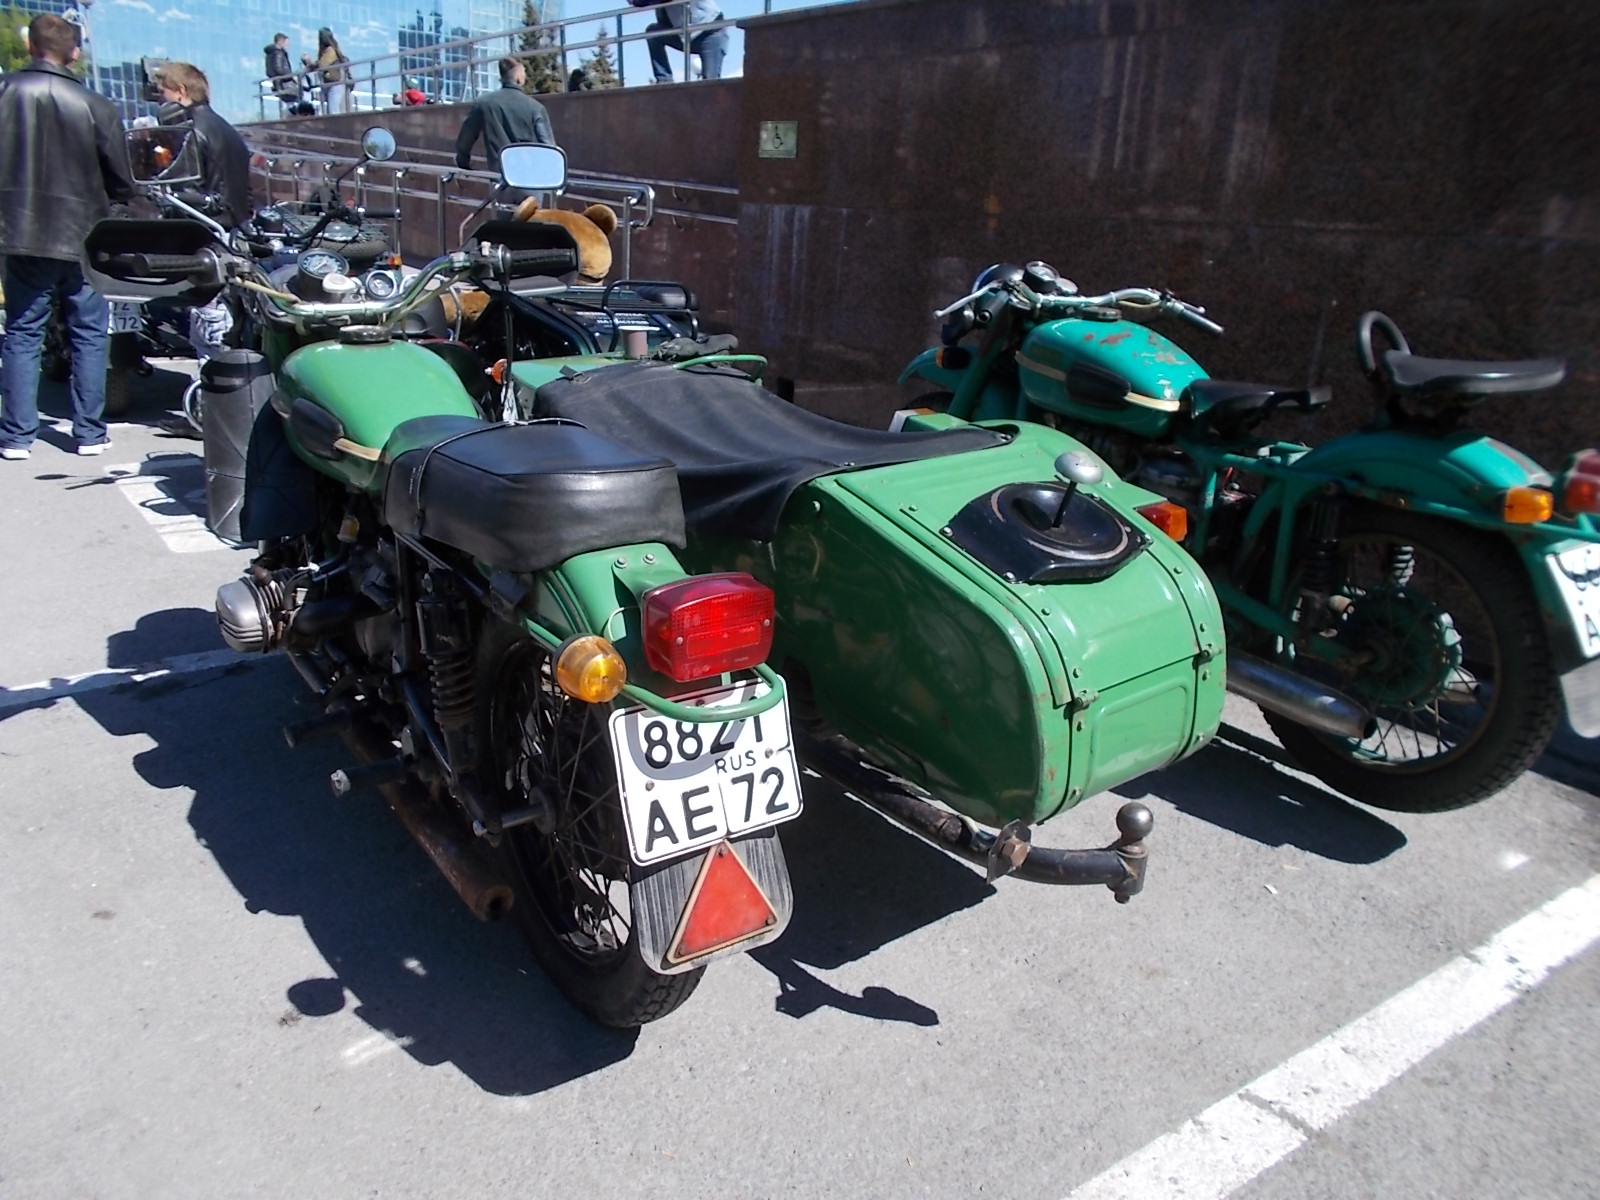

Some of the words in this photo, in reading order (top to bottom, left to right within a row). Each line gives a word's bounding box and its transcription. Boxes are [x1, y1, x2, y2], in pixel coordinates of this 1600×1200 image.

[118, 316, 139, 330] 72
[714, 749, 757, 774] RUS
[644, 785, 718, 853] AE
[731, 766, 789, 823] 72
